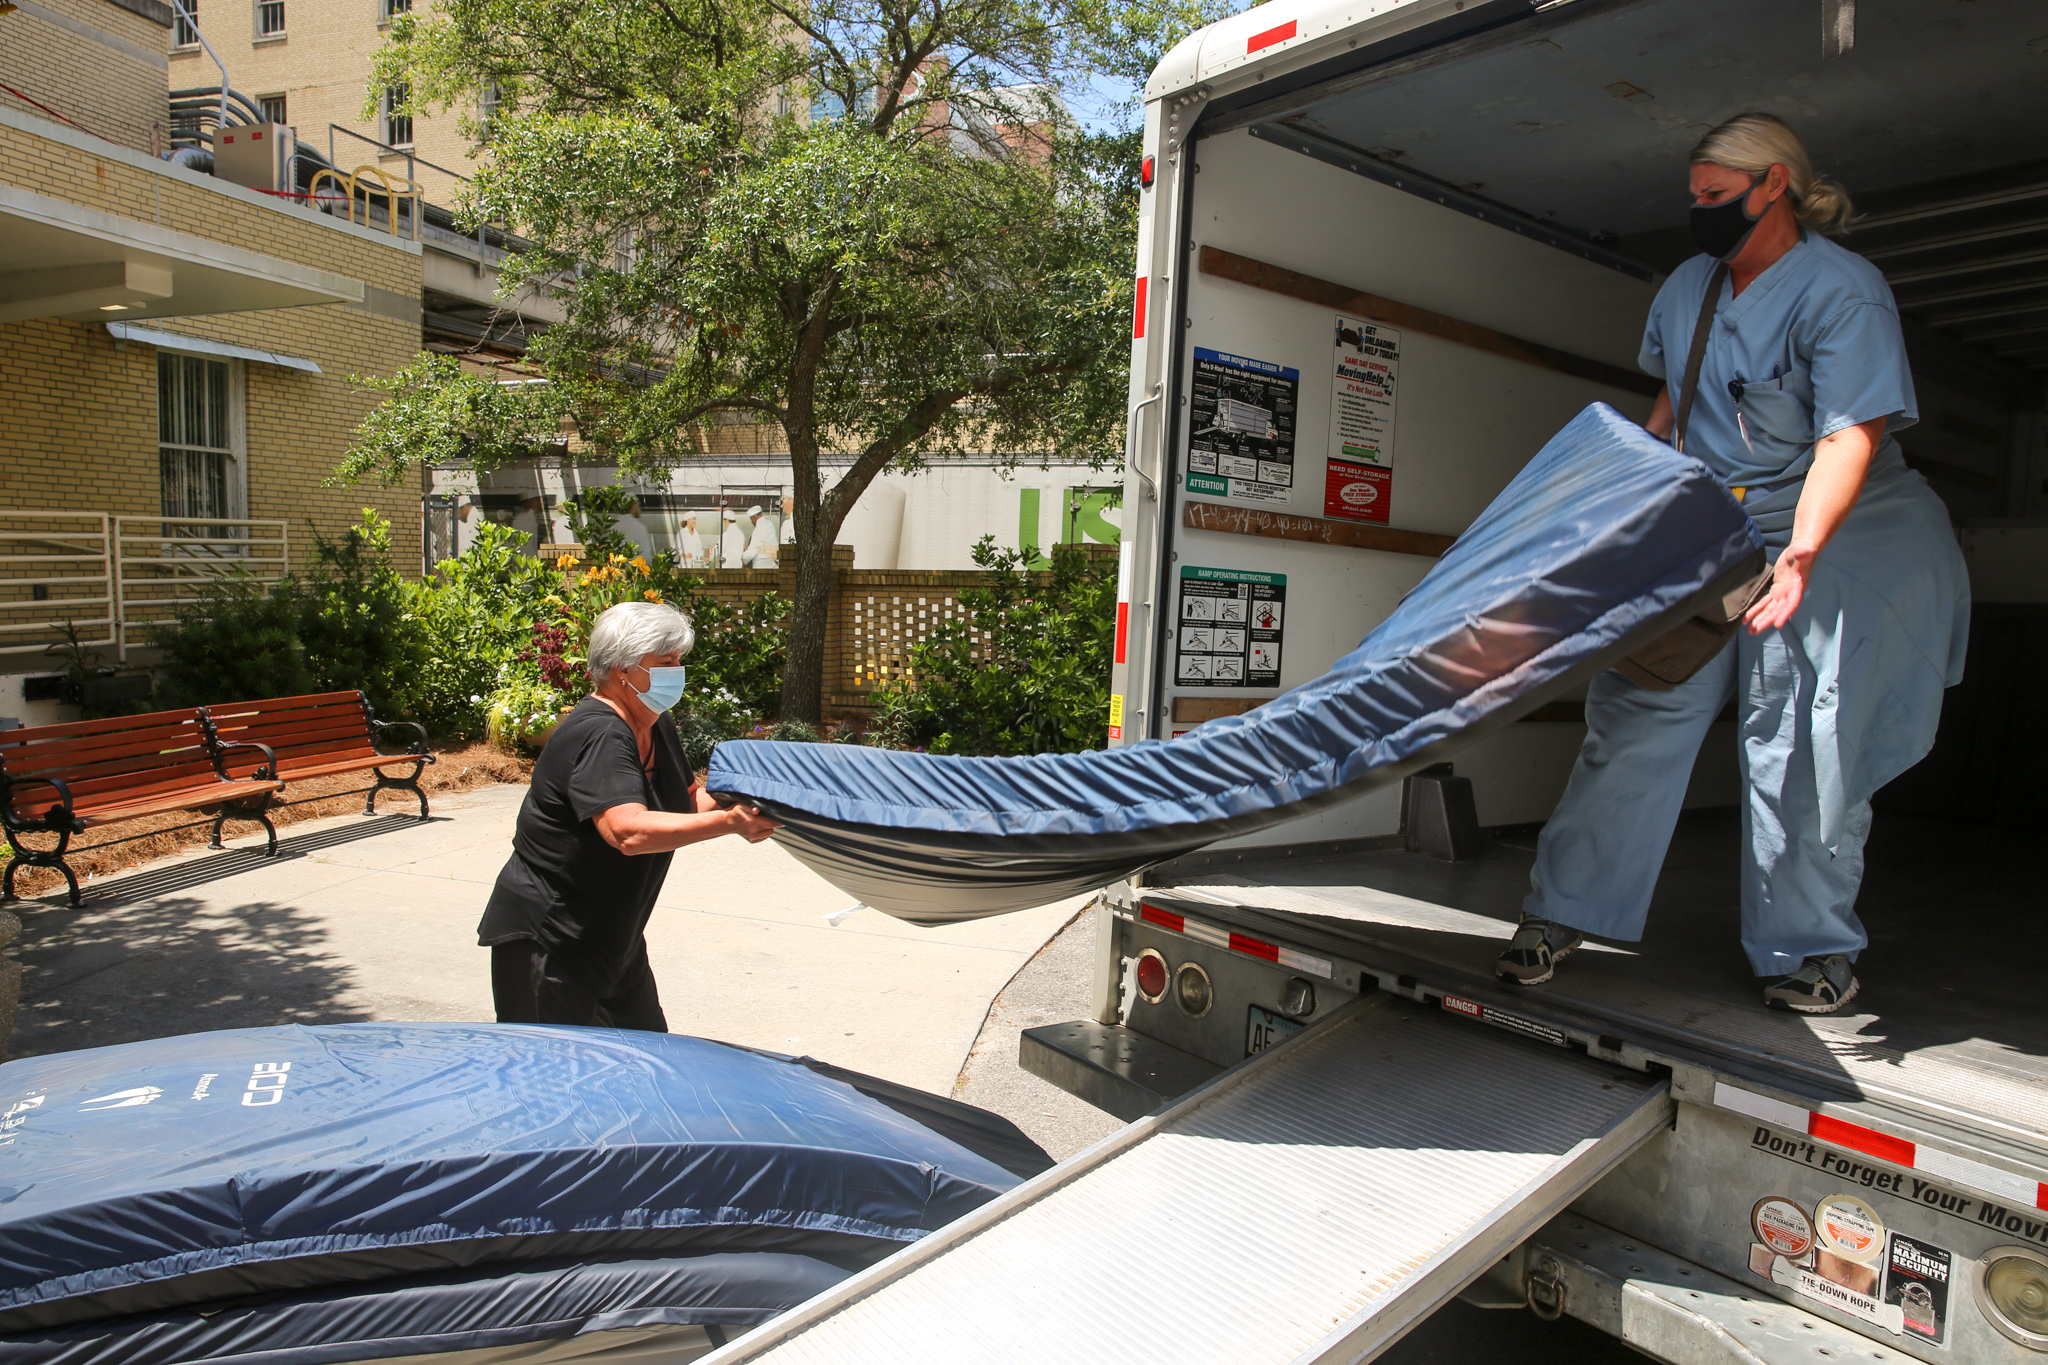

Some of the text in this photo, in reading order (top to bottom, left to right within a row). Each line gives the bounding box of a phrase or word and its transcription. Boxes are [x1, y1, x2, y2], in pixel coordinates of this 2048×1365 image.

[1366, 326, 1377, 336] GET
[1365, 335, 1396, 351] UNLOADING
[1364, 345, 1400, 361] HELP TODAY!
[1219, 354, 1277, 372] YOUR MOVING MADE EASIER
[1345, 356, 1388, 373] SAME DAY SERVICE
[1200, 362, 1210, 371] Only
[1241, 371, 1250, 379] right
[1251, 374, 1270, 383] equipment
[1356, 385, 1364, 393] Not
[1365, 387, 1373, 395] Too
[1373, 389, 1384, 397] Late
[1347, 468, 1390, 479] SELF-STORAGE
[1190, 478, 1224, 491] ATTENTION
[1213, 571, 1238, 579] OPERATING
[1240, 574, 1272, 582] INSTRUCTIONS
[1446, 997, 1478, 1014] DANGER
[1752, 1126, 1816, 1163] Don't
[1821, 1152, 1903, 1192] Forget
[1912, 1178, 1970, 1214] Your
[1892, 1255, 1948, 1281] SECURITY
[1894, 1246, 1948, 1273] MAXIMUM
[1802, 1275, 1848, 1301] TIE-DOWN
[1850, 1296, 1876, 1313] ROPE
